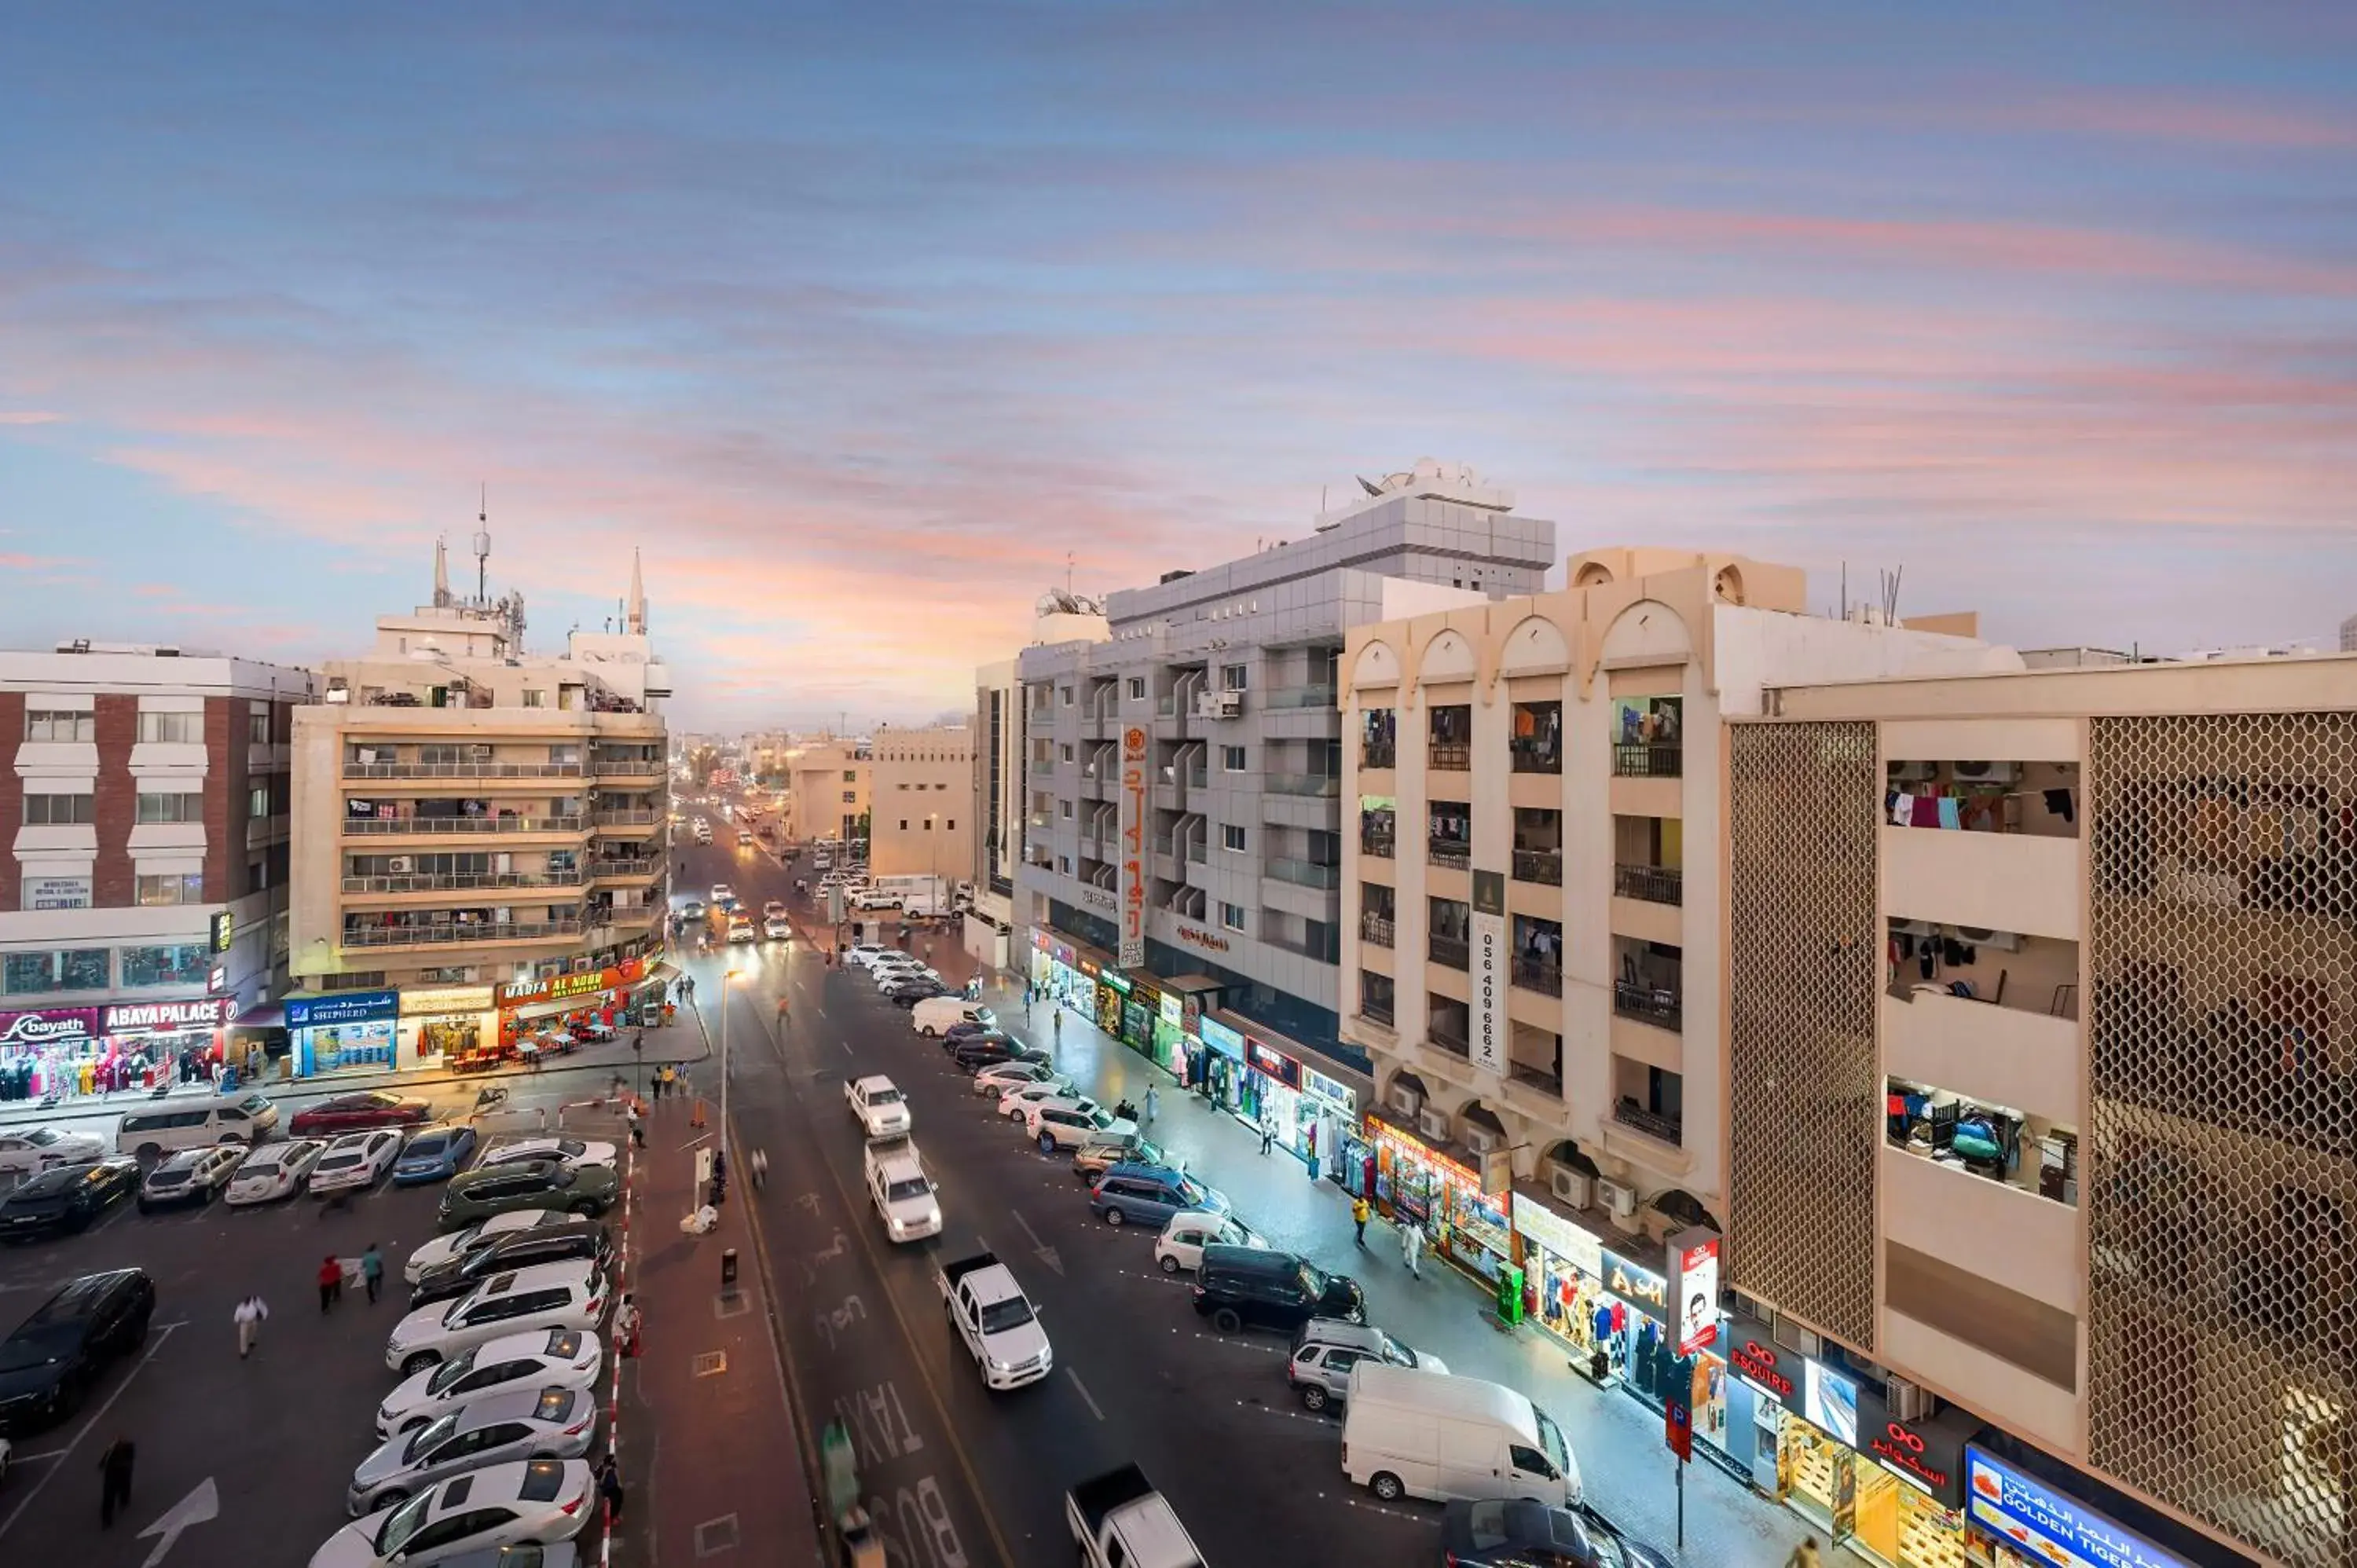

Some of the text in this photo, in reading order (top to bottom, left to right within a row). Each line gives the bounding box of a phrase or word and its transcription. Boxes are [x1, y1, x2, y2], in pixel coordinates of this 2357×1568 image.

[107, 1006, 160, 1027] ABAYA
[159, 1002, 219, 1022] PALACE
[1732, 1349, 1793, 1396] ESQUIRE
[2003, 1493, 2074, 1541] GOLDEN
